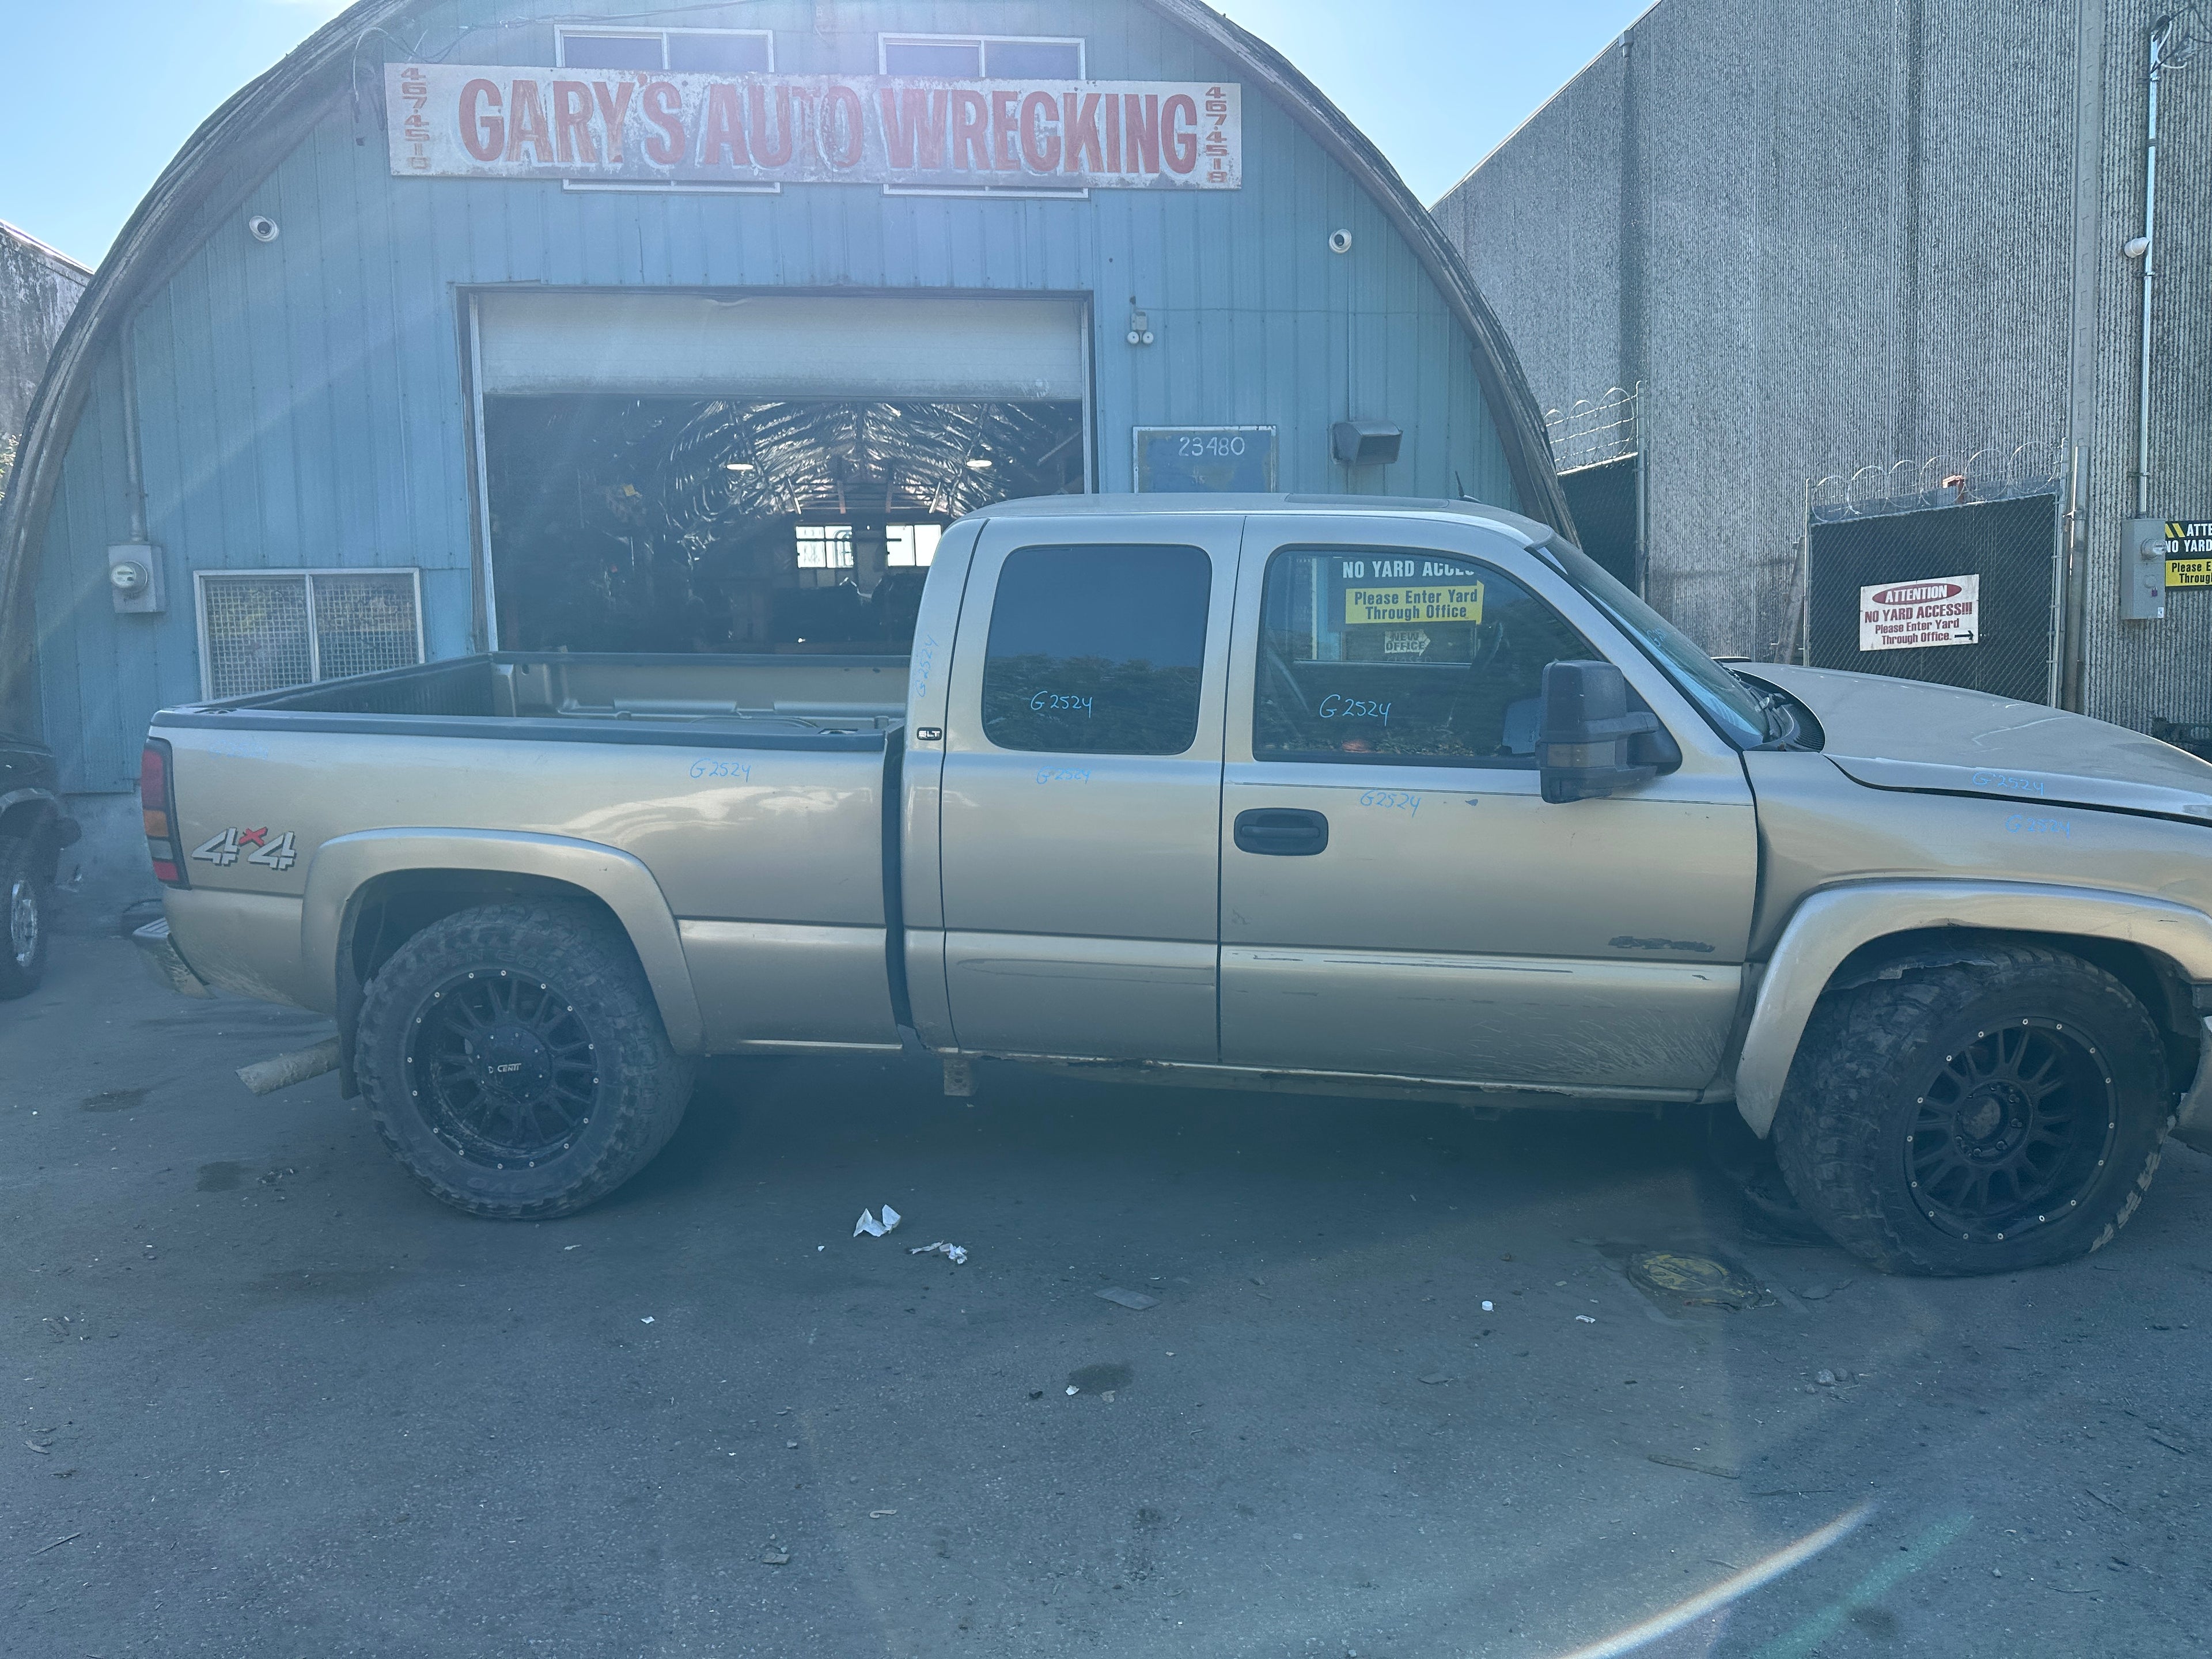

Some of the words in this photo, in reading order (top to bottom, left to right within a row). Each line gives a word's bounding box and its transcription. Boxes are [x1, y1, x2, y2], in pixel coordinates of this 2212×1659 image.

[459, 74, 686, 165] GARY'S
[704, 84, 863, 167] AUTO
[880, 88, 1198, 173] WRECKING
[1179, 437, 1245, 456] 23480
[2165, 540, 2179, 552] NO
[2184, 539, 2212, 552] YARD
[1343, 562, 1364, 578] NO
[1372, 560, 1414, 577] YARD
[2172, 562, 2202, 573] Please
[2179, 573, 2212, 584] Throug
[1354, 591, 1399, 605] Please
[1406, 590, 1442, 604] Enter
[1448, 589, 1478, 603] Yard
[1885, 585, 1948, 603] ATTENTION
[1365, 605, 1420, 621] Through
[1426, 604, 1467, 618] Office
[1865, 611, 1878, 623] NO
[1883, 607, 1913, 621] YARD
[1916, 602, 1972, 619] ACCESS!!!
[1875, 624, 1903, 634] Please
[1906, 622, 1932, 631] Enter
[1936, 618, 1959, 630] Yard
[1386, 641, 1426, 651] OFFICE
[1390, 633, 1419, 641] NEW
[1882, 634, 1918, 645] Through
[1031, 691, 1093, 718] G2524
[1319, 694, 1392, 726] G2524
[918, 730, 940, 738] SLT
[690, 758, 751, 782] G2524
[1036, 766, 1092, 784] G2524
[1972, 772, 2044, 796] G2524
[1360, 789, 1422, 818] G2524
[2006, 814, 2070, 839] G2524
